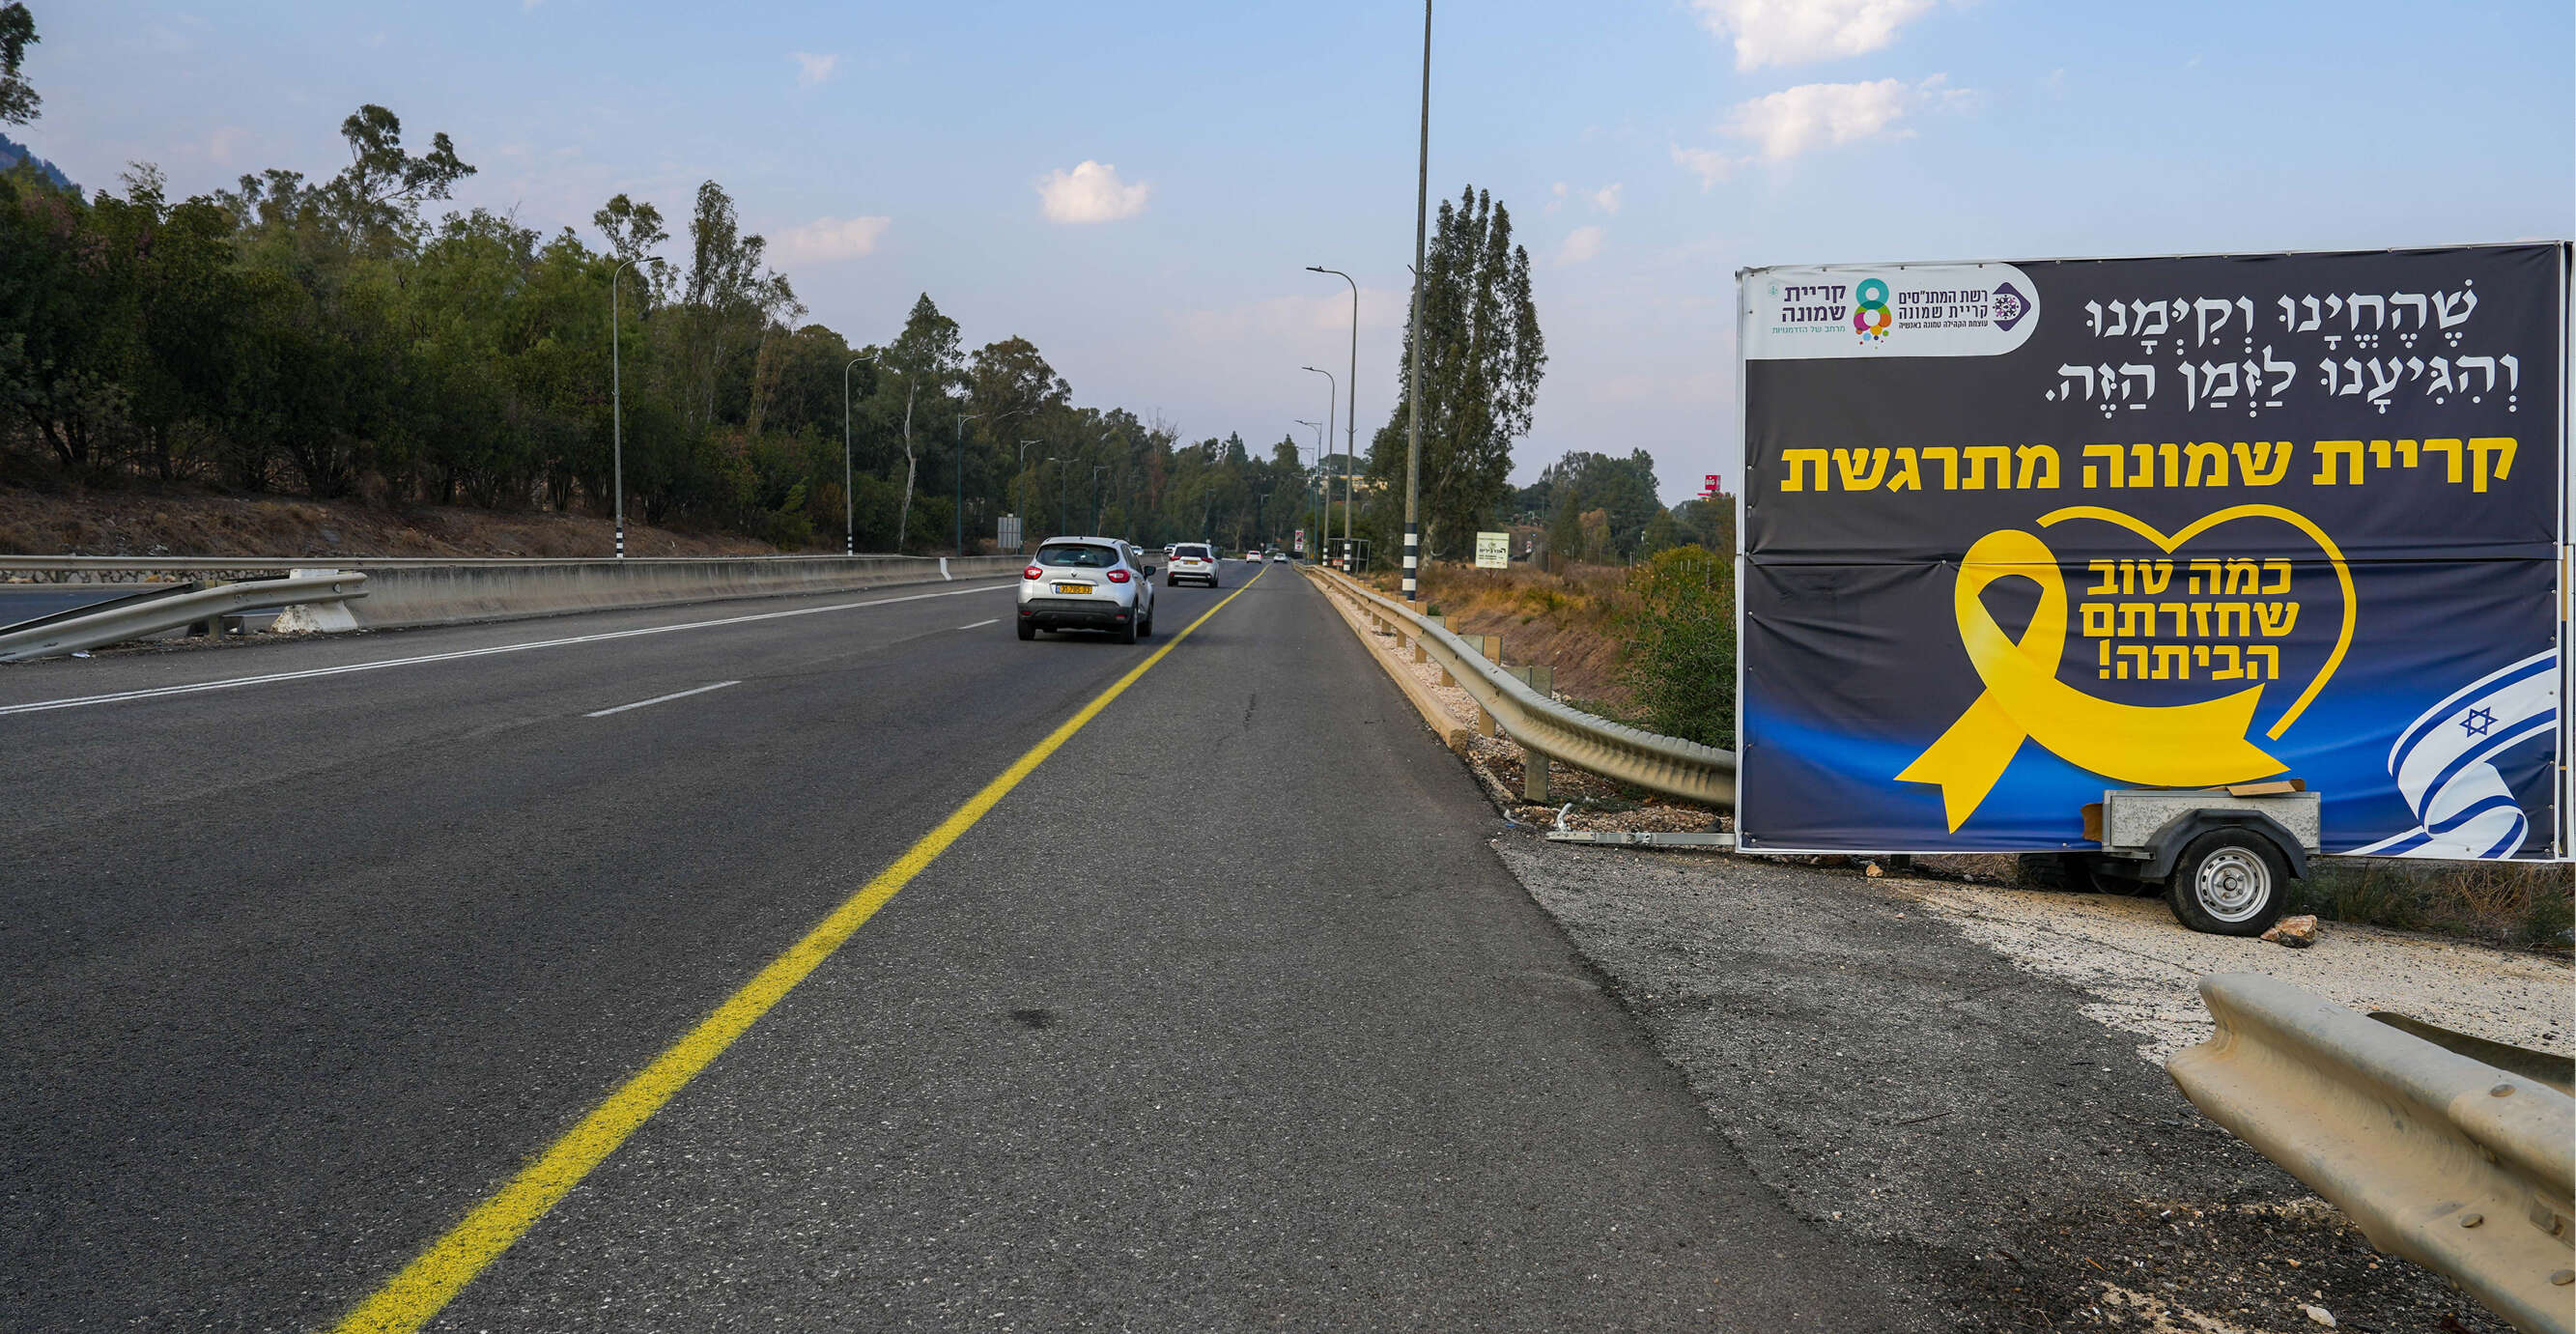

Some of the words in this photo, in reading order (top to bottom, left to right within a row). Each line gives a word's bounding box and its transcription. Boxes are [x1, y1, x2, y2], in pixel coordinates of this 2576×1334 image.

[1784, 286, 1847, 303] קריית
[1898, 305, 1943, 320] שמונה
[1948, 304, 1988, 319] קריית
[1960, 290, 1988, 303] רשת
[1782, 305, 1847, 323] שמונה
[1780, 443, 2060, 493] מתרגשת
[2082, 440, 2294, 489] שמונה
[2313, 437, 2518, 494] קריית
[2086, 558, 2174, 595] טוב
[2189, 557, 2292, 595] כמה
[2079, 602, 2301, 638] שחזרתם
[2099, 639, 2279, 680] הביתה!
